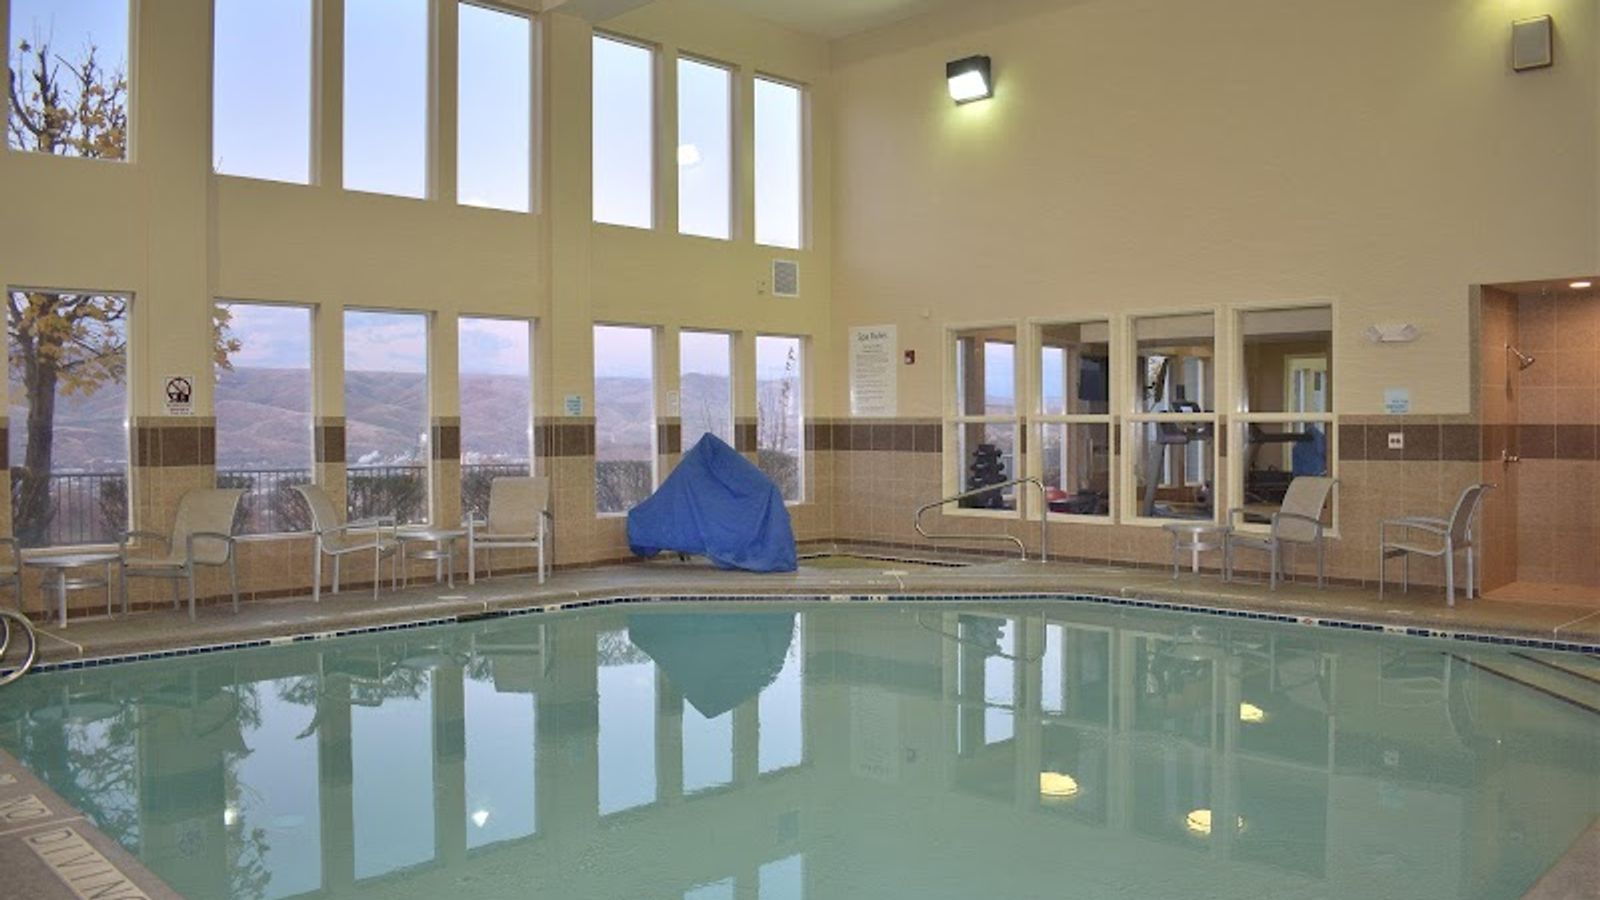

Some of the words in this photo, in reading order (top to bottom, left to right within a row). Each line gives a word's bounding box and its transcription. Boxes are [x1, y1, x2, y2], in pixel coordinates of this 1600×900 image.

[857, 331, 869, 342] Spa
[870, 331, 887, 340] Rules
[29, 828, 149, 900] DIVIN
